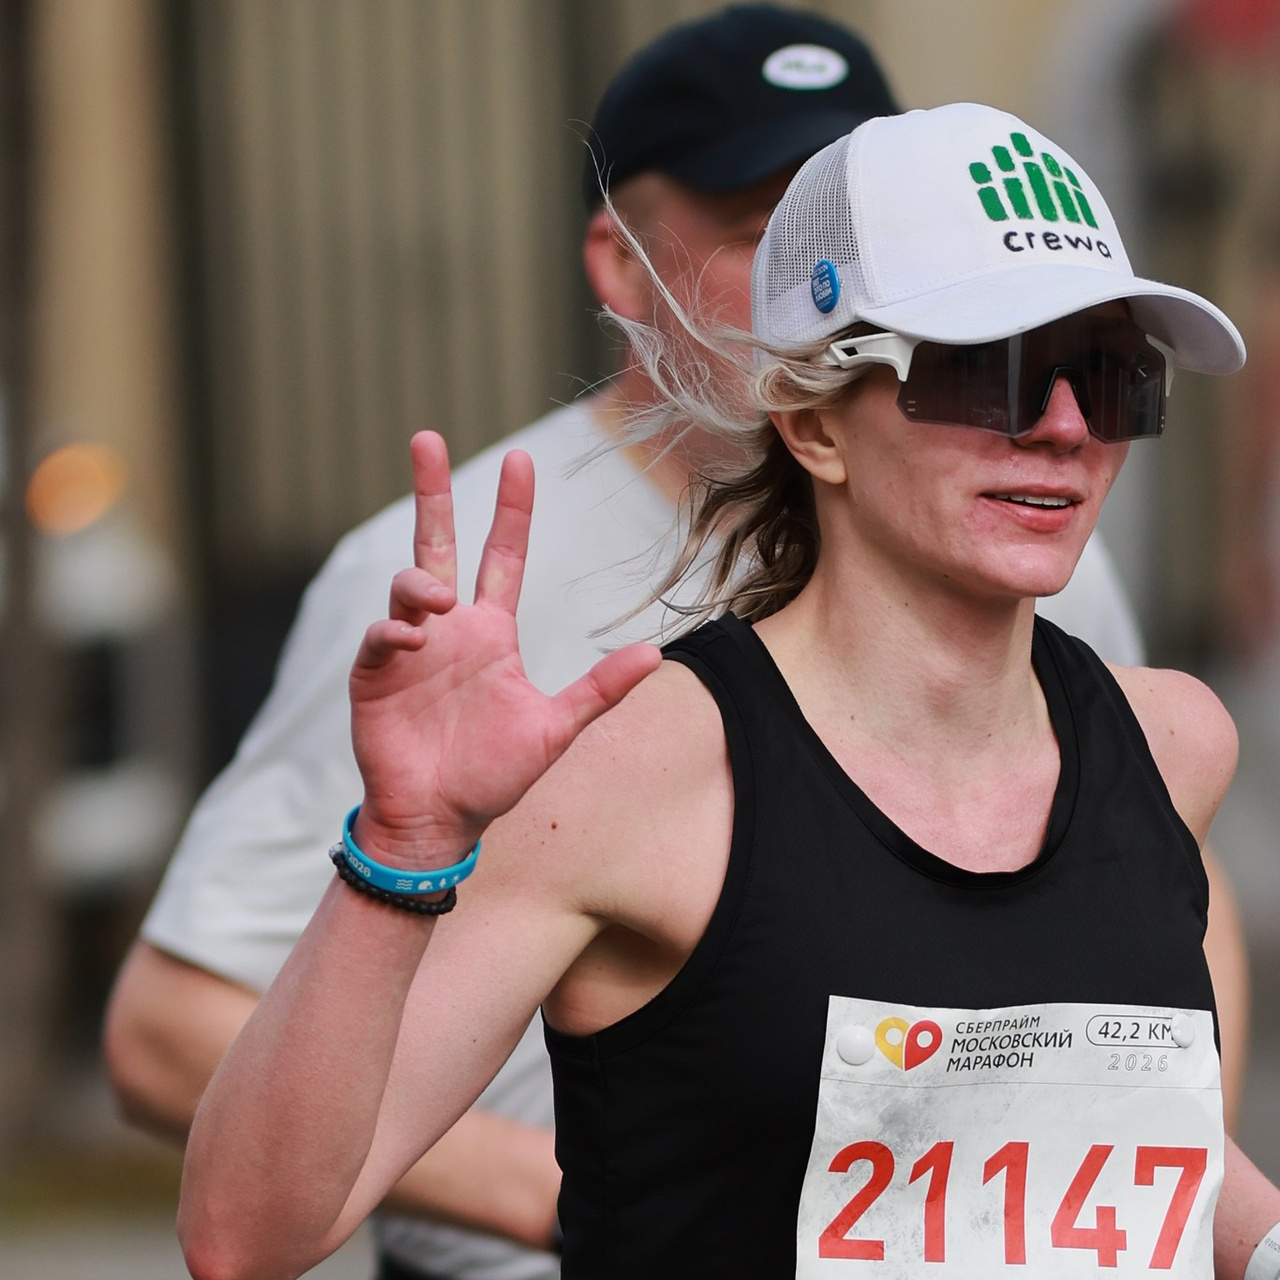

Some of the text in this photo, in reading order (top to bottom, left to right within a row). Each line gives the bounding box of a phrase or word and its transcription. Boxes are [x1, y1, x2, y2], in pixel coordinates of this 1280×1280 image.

[348, 851, 372, 878] 2026
[955, 1015, 1041, 1035] СБЕРПРАЙМ
[1098, 1021, 1140, 1042] 42,2
[950, 1029, 1073, 1054] МОСКОВСКИЙ
[946, 1052, 1034, 1073] МАРАФОН
[1107, 1053, 1168, 1072] 2026
[818, 1140, 1208, 1269] 21147
